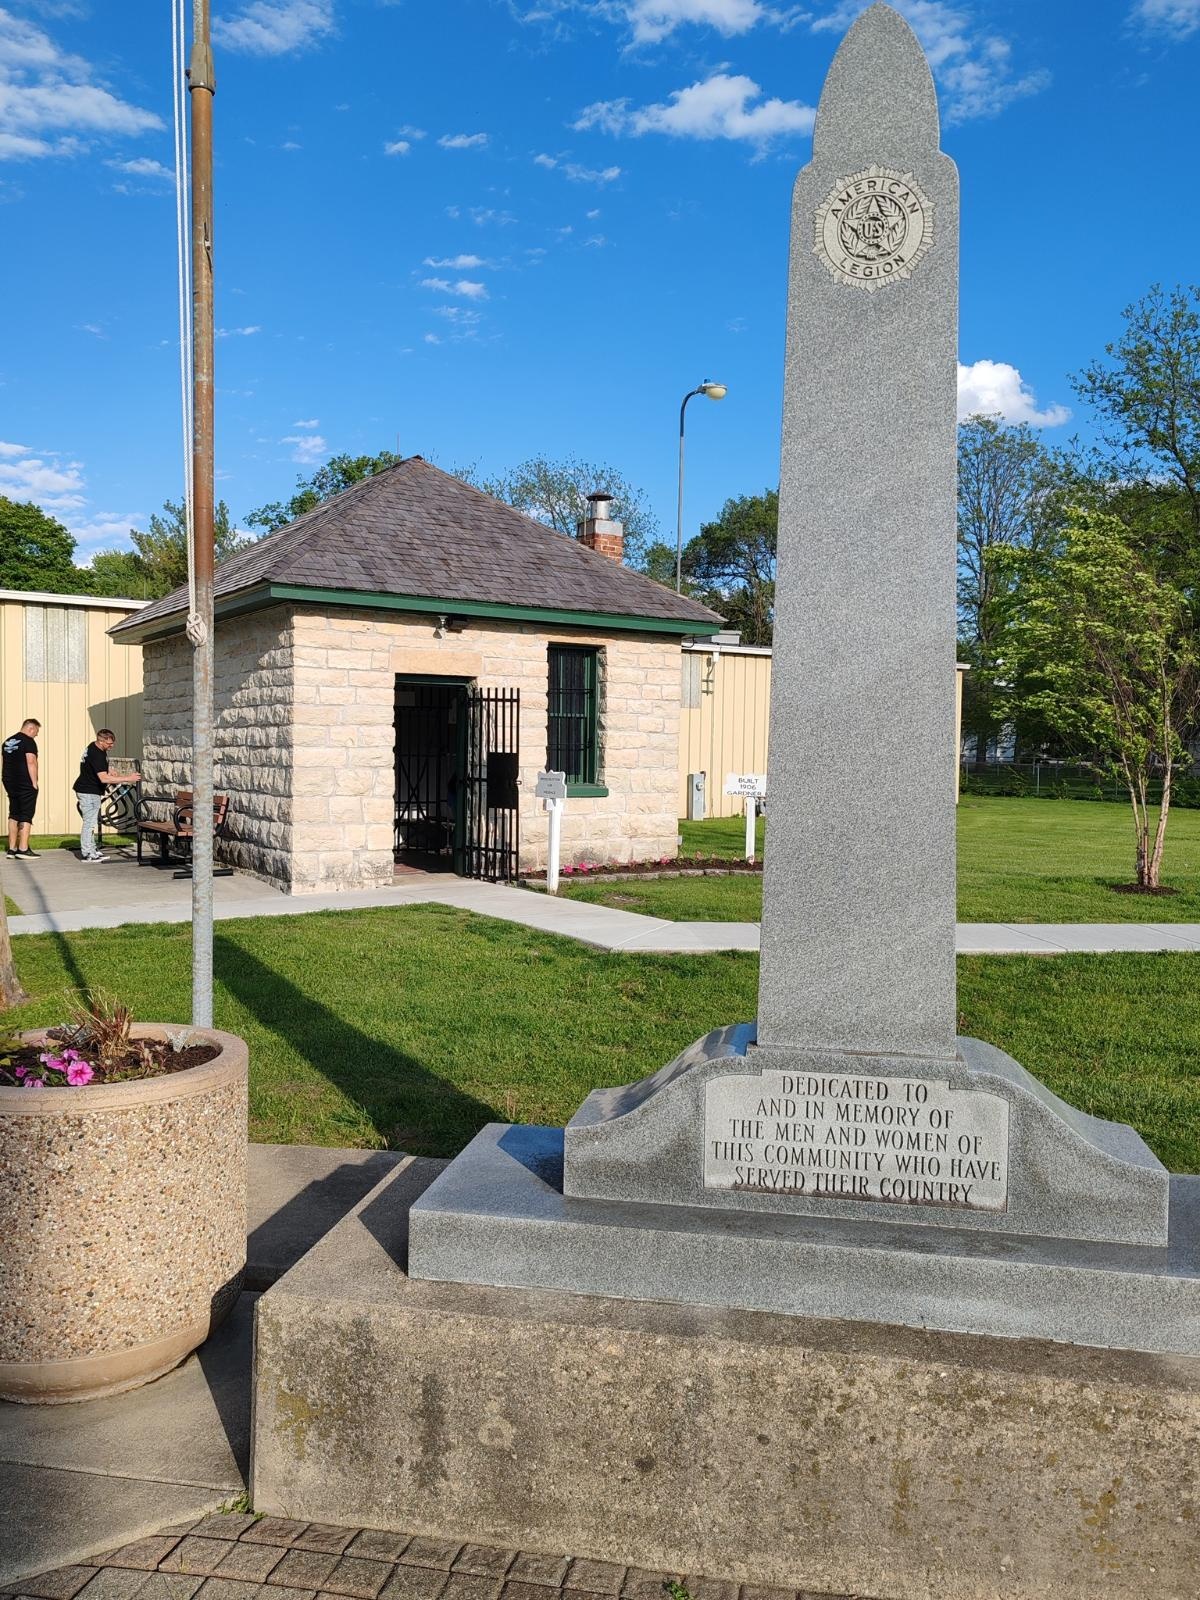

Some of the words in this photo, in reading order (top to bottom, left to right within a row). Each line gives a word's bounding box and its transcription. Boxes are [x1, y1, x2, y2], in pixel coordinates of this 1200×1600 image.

[831, 180, 920, 219] AMERICAN
[839, 254, 905, 278] LEGION
[782, 1075, 889, 1101] DEDICATED
[903, 1083, 928, 1104] TO
[756, 1098, 796, 1119] AND
[805, 1101, 825, 1120] IN
[835, 1102, 920, 1127] MEMORY
[929, 1108, 954, 1129] OF
[729, 1118, 765, 1140] THE
[775, 1122, 816, 1143] MEN
[825, 1126, 866, 1147] AND
[875, 1128, 949, 1153] WOMEN
[958, 1134, 983, 1156] OF
[711, 1140, 754, 1163] THIS
[764, 1144, 886, 1172] COMMUNITY
[895, 1154, 941, 1177] WHO
[951, 1158, 1001, 1181] HAVE
[734, 1165, 806, 1190] SERVED
[812, 1172, 869, 1195] THEIR
[879, 1177, 974, 1203] COUNTRY
